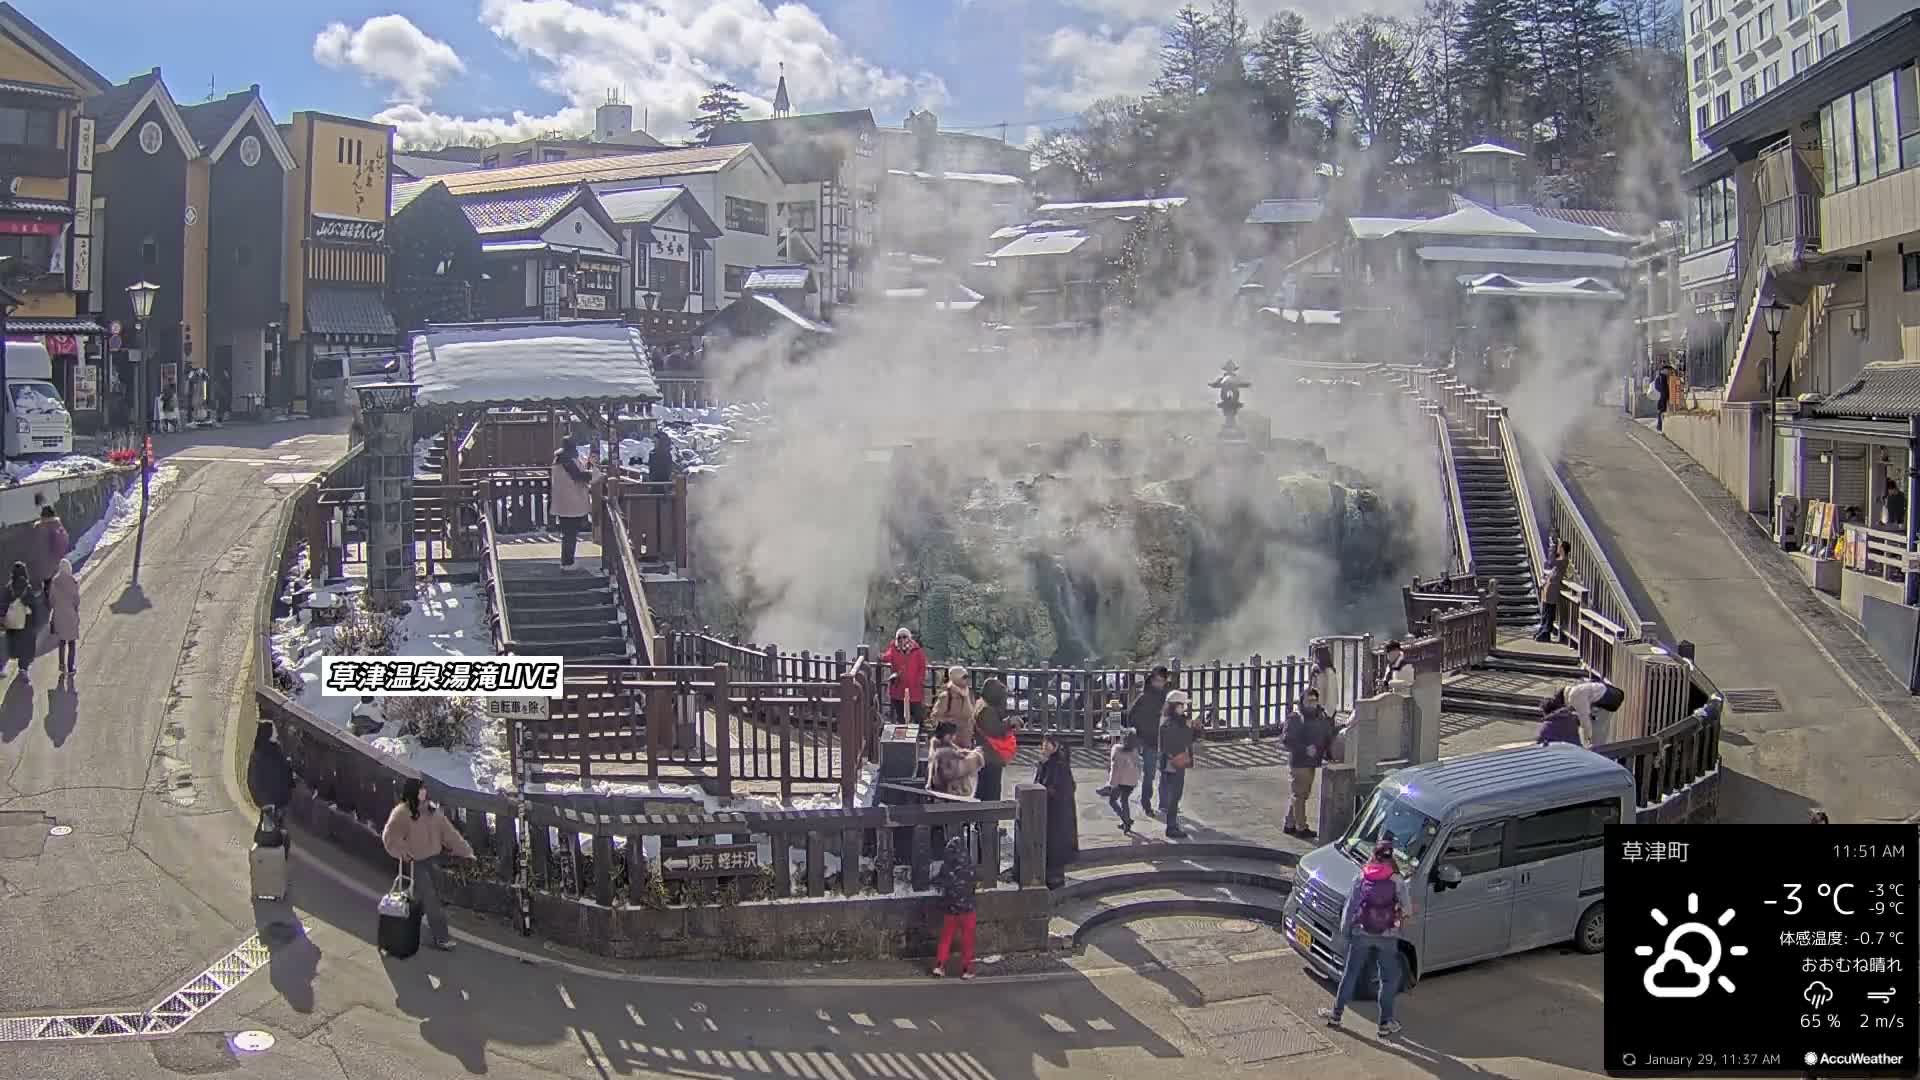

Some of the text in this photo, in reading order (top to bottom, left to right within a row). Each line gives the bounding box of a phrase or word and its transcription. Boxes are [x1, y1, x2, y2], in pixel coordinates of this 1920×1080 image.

[688, 851, 757, 871] 東京 軽井沢
